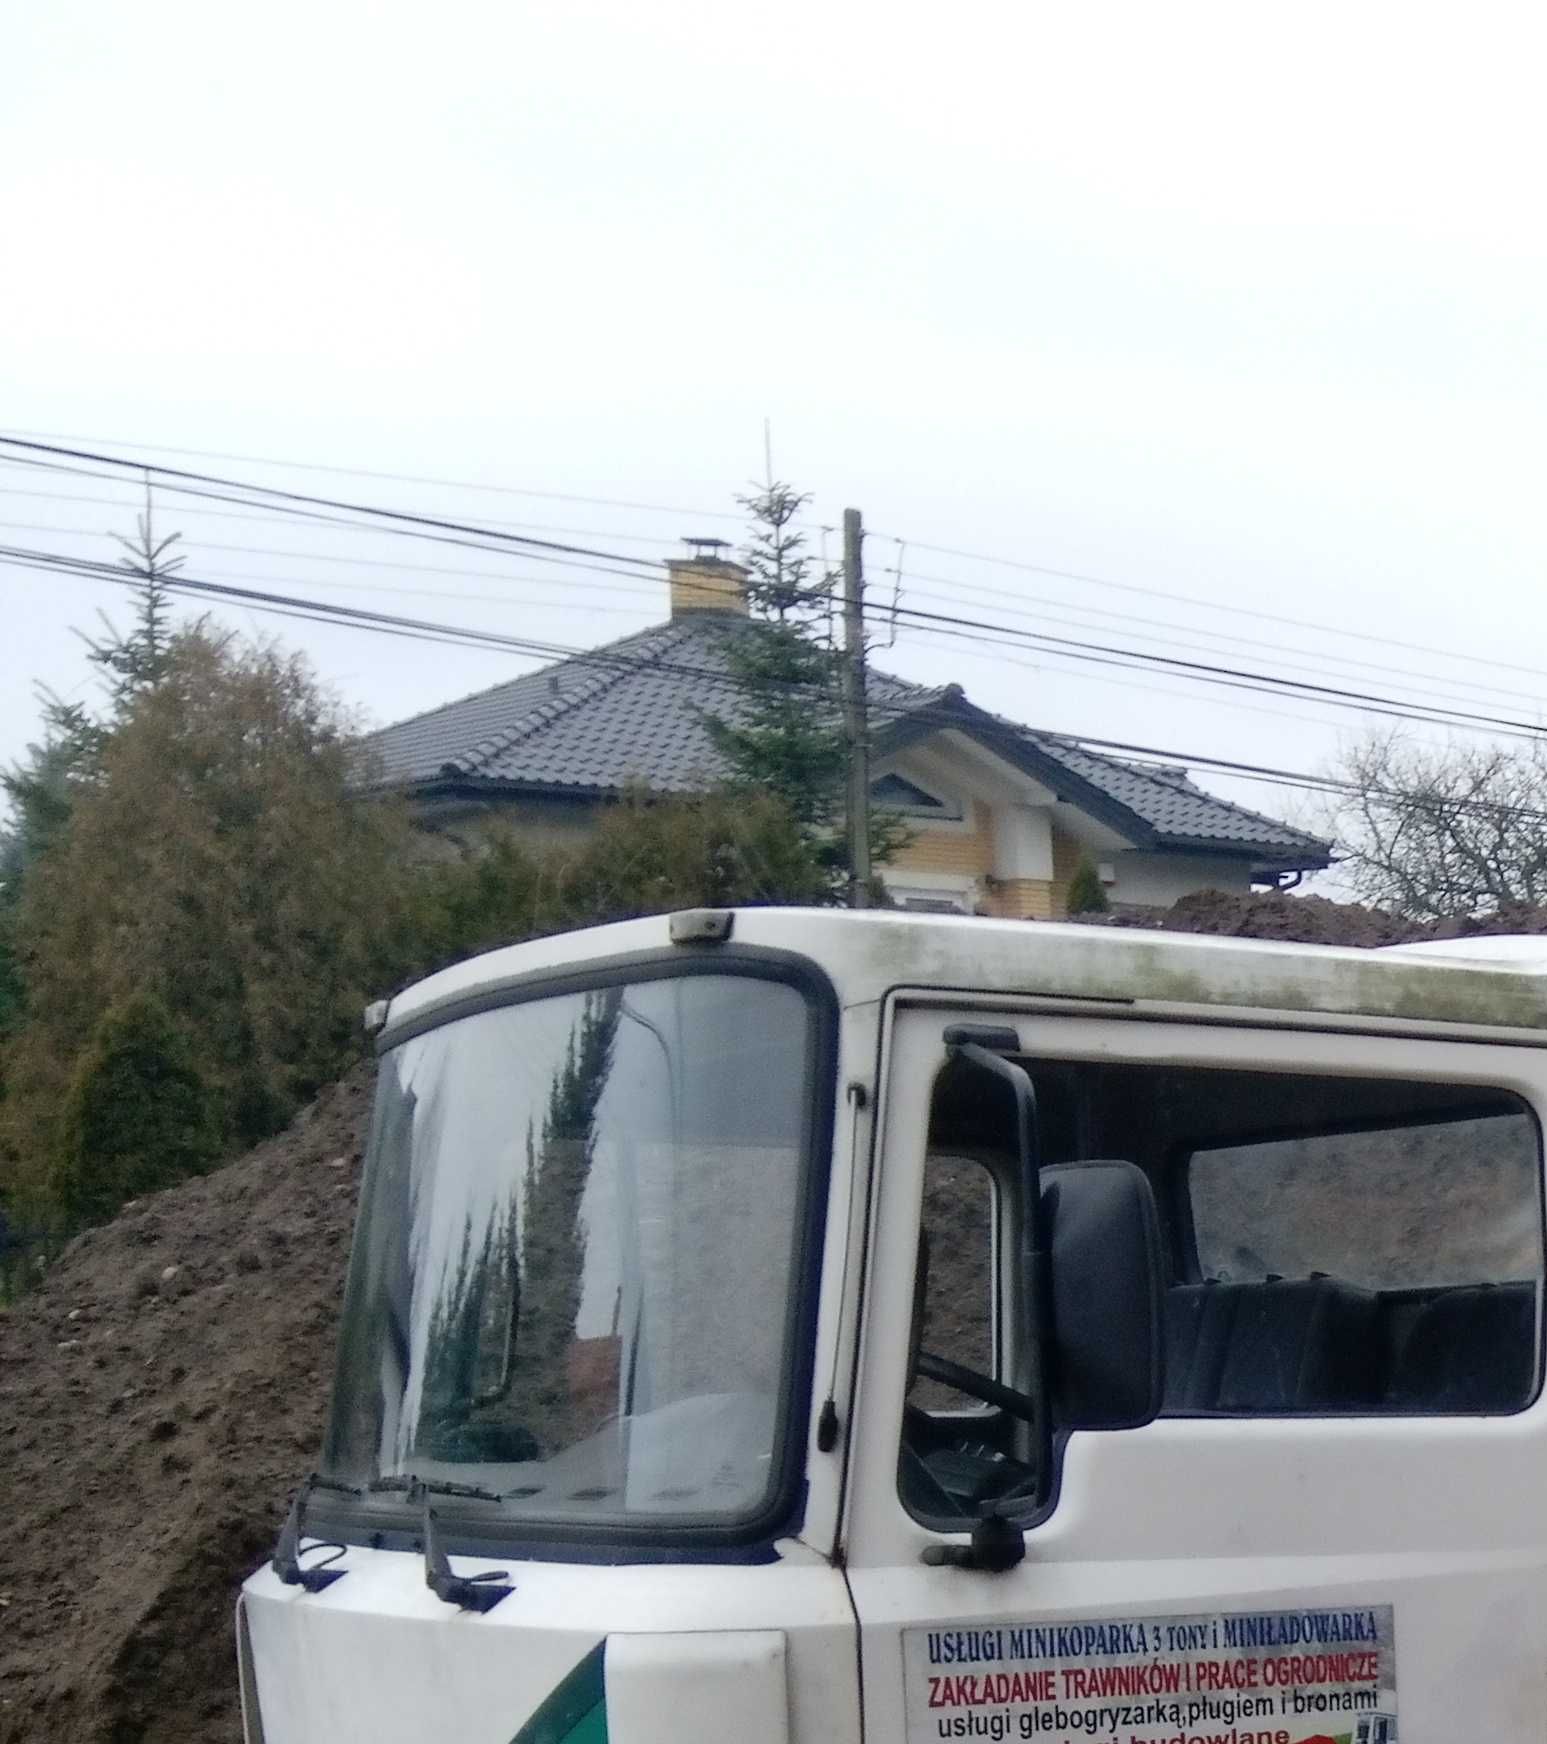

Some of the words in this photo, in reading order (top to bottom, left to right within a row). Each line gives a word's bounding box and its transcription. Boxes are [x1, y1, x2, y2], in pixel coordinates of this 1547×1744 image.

[928, 1629, 1001, 1664] USŁUGI
[1009, 1622, 1149, 1660] MINIKOPARKĄ
[1153, 1626, 1162, 1652] 3
[1167, 1623, 1207, 1651] TONY
[928, 1670, 1057, 1708] ZAKŁADANIE
[1061, 1658, 1180, 1699] TRAWNIKÓW
[1185, 1664, 1192, 1692] I
[1196, 1657, 1258, 1691] PRACE
[1264, 1651, 1378, 1687] OGRODNICZE
[938, 1708, 1011, 1740] usługi
[1281, 1691, 1287, 1714] i
[1293, 1685, 1378, 1713] bronami
